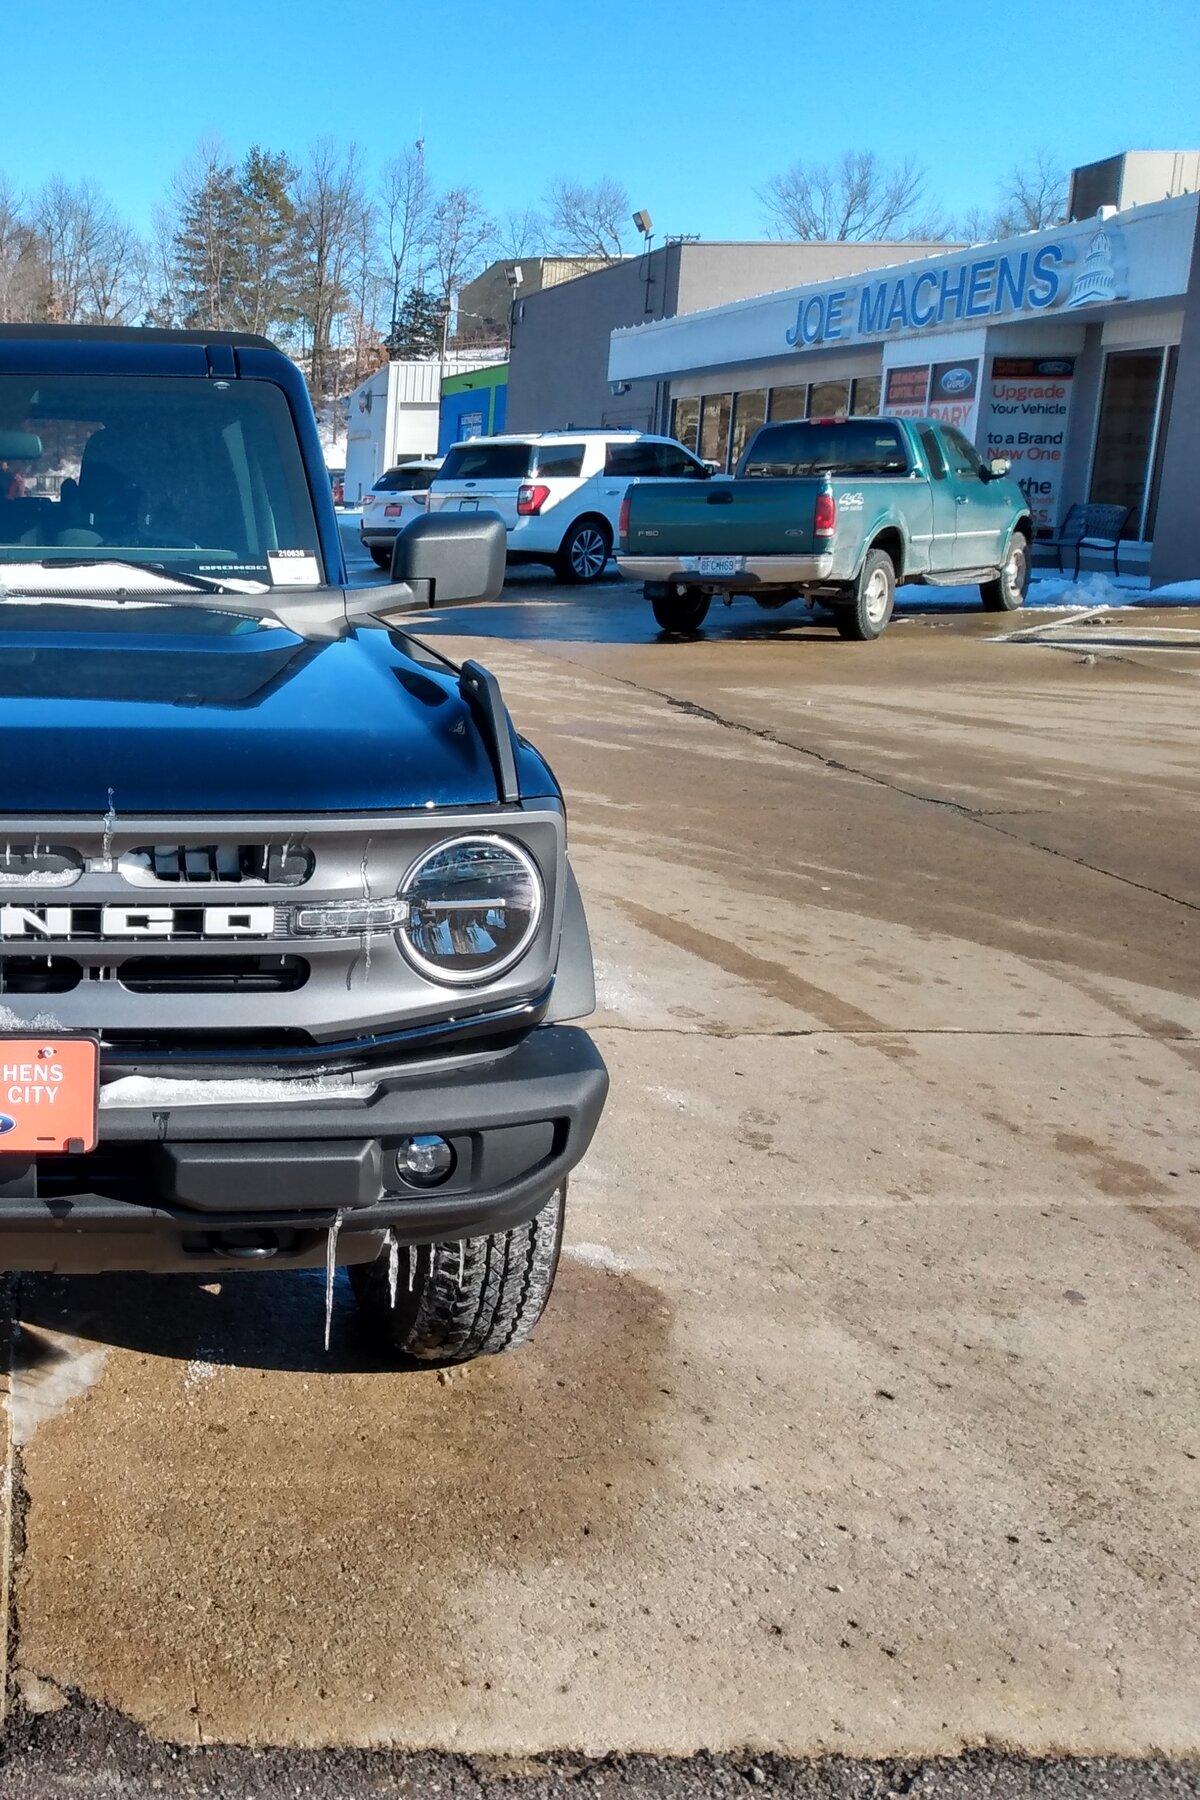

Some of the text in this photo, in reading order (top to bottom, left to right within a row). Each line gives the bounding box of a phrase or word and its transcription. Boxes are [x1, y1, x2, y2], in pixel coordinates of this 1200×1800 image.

[785, 245, 1063, 346] JOE MACHENS
[992, 385, 1066, 401] Upgrade
[991, 403, 1067, 414] Your Vehicle
[987, 432, 1064, 444] to a Brand
[987, 447, 1062, 460] New One
[7, 1086, 59, 1104] CITY
